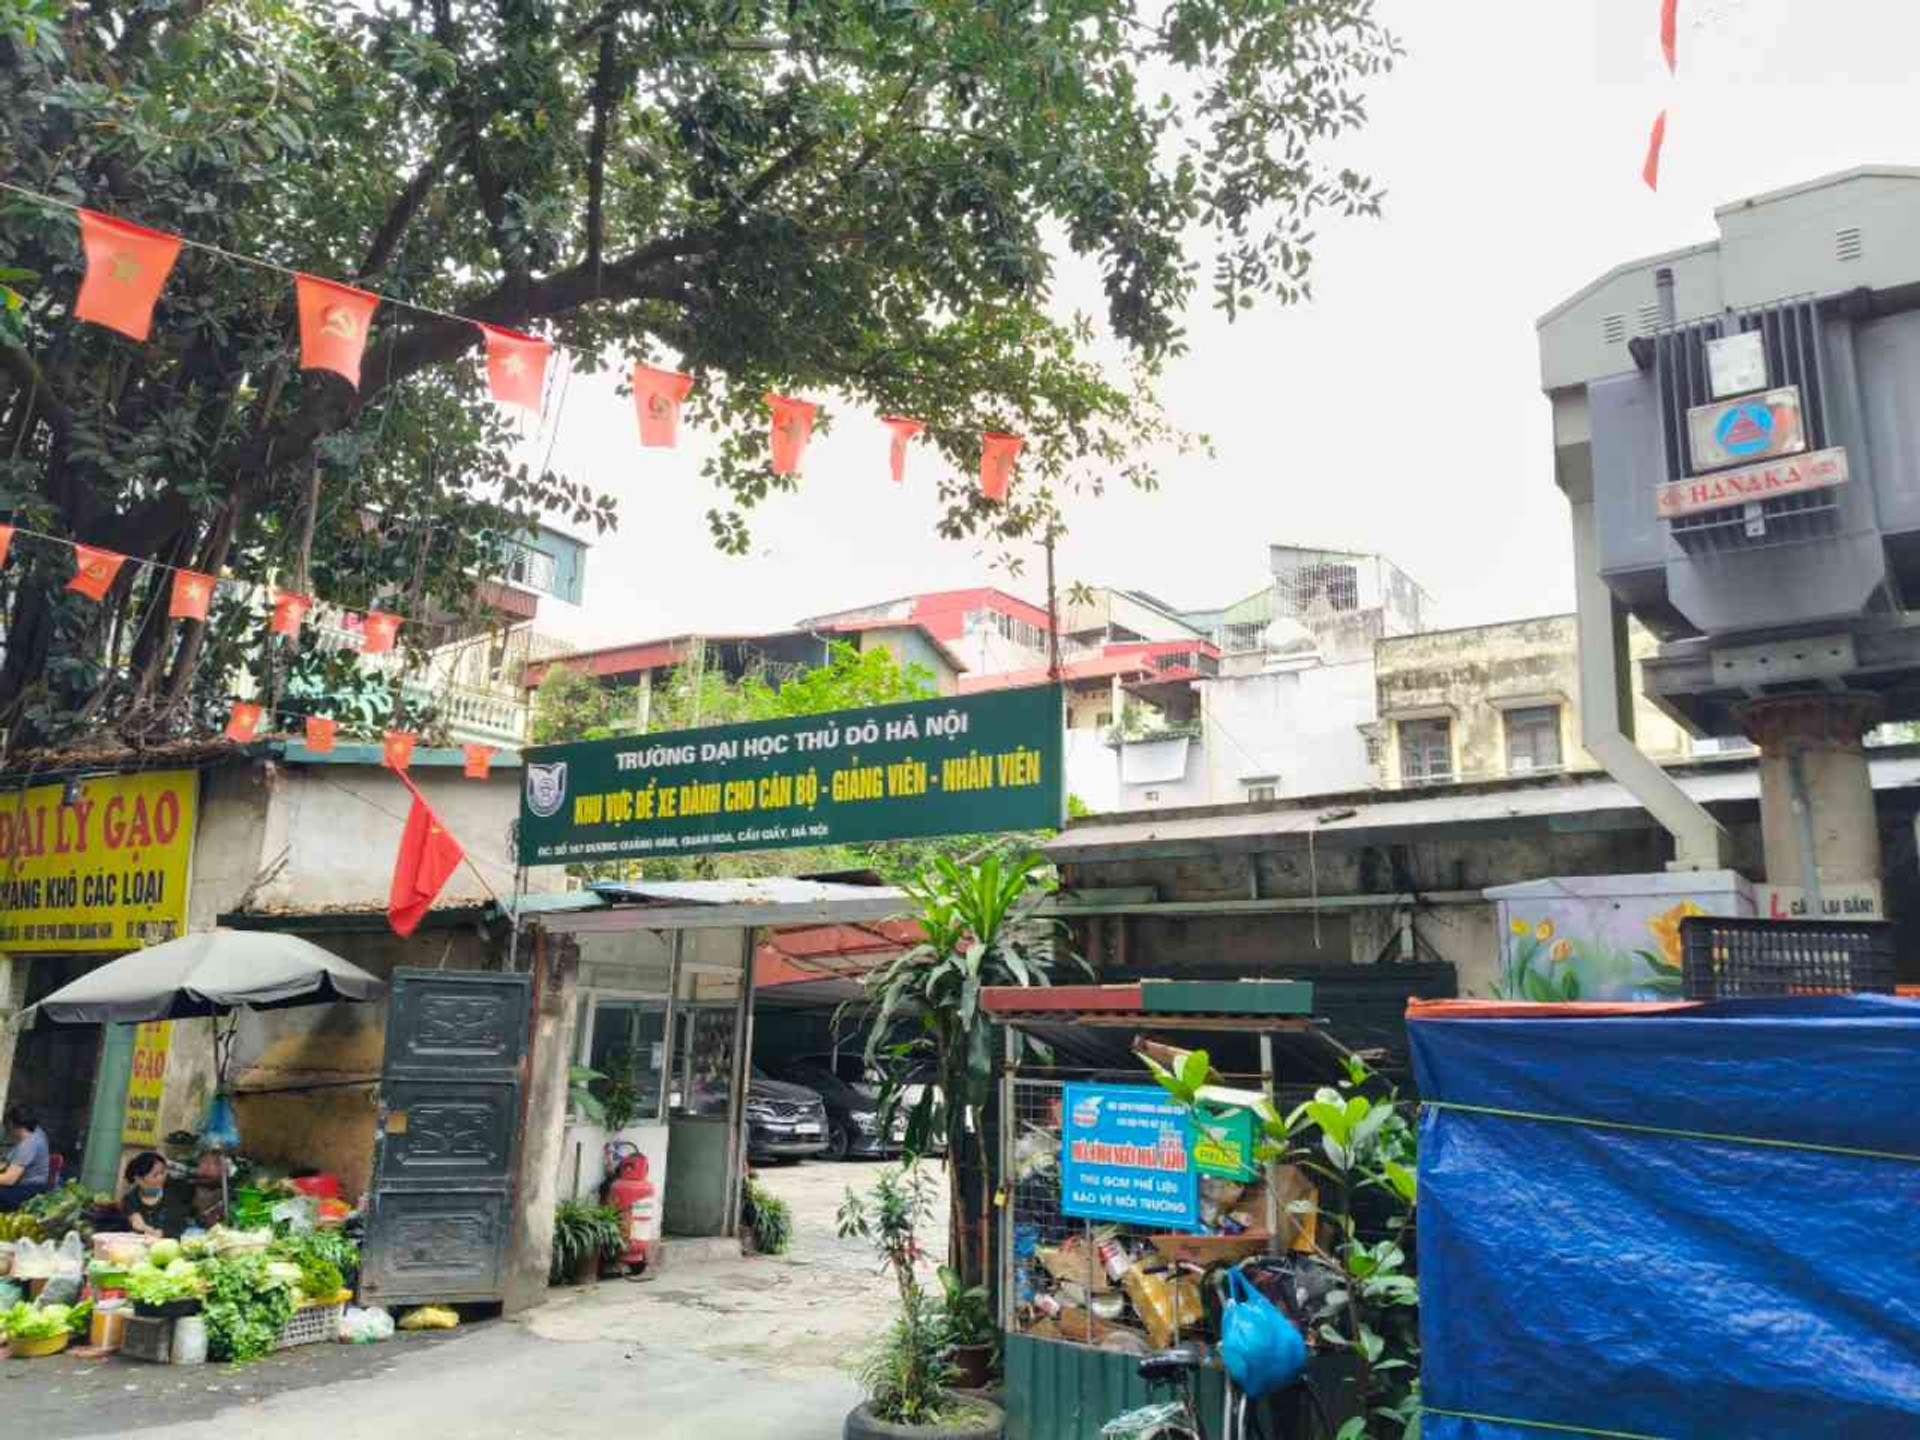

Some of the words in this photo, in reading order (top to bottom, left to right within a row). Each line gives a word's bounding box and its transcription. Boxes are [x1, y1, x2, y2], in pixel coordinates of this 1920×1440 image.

[1690, 466, 1801, 503] HANAKA
[616, 744, 696, 771] TRƯỜNG
[701, 741, 738, 765] ĐẠI
[744, 735, 789, 761] HỌC
[794, 720, 840, 751] THỦ
[845, 719, 879, 745] ĐÔ
[886, 714, 919, 740] HÀ
[926, 709, 969, 740] NỘI
[574, 795, 603, 825] KHU
[605, 790, 634, 827] VỰC
[635, 777, 655, 819] ĐỂ
[657, 786, 677, 818] XE
[680, 780, 721, 816] DÀNH
[725, 779, 755, 812] CHO
[760, 771, 793, 809] CÁN
[796, 767, 817, 811] BỘ
[832, 756, 884, 802] GIẢNG
[888, 756, 926, 796] VIÊN
[942, 751, 993, 792] NHÂN
[998, 745, 1041, 786] VIÊN
[54, 786, 95, 853] LÝ
[103, 790, 180, 864] GẠO
[46, 869, 78, 909] KHÔ
[83, 866, 118, 907] CÁC
[122, 868, 165, 912] LOẠI
